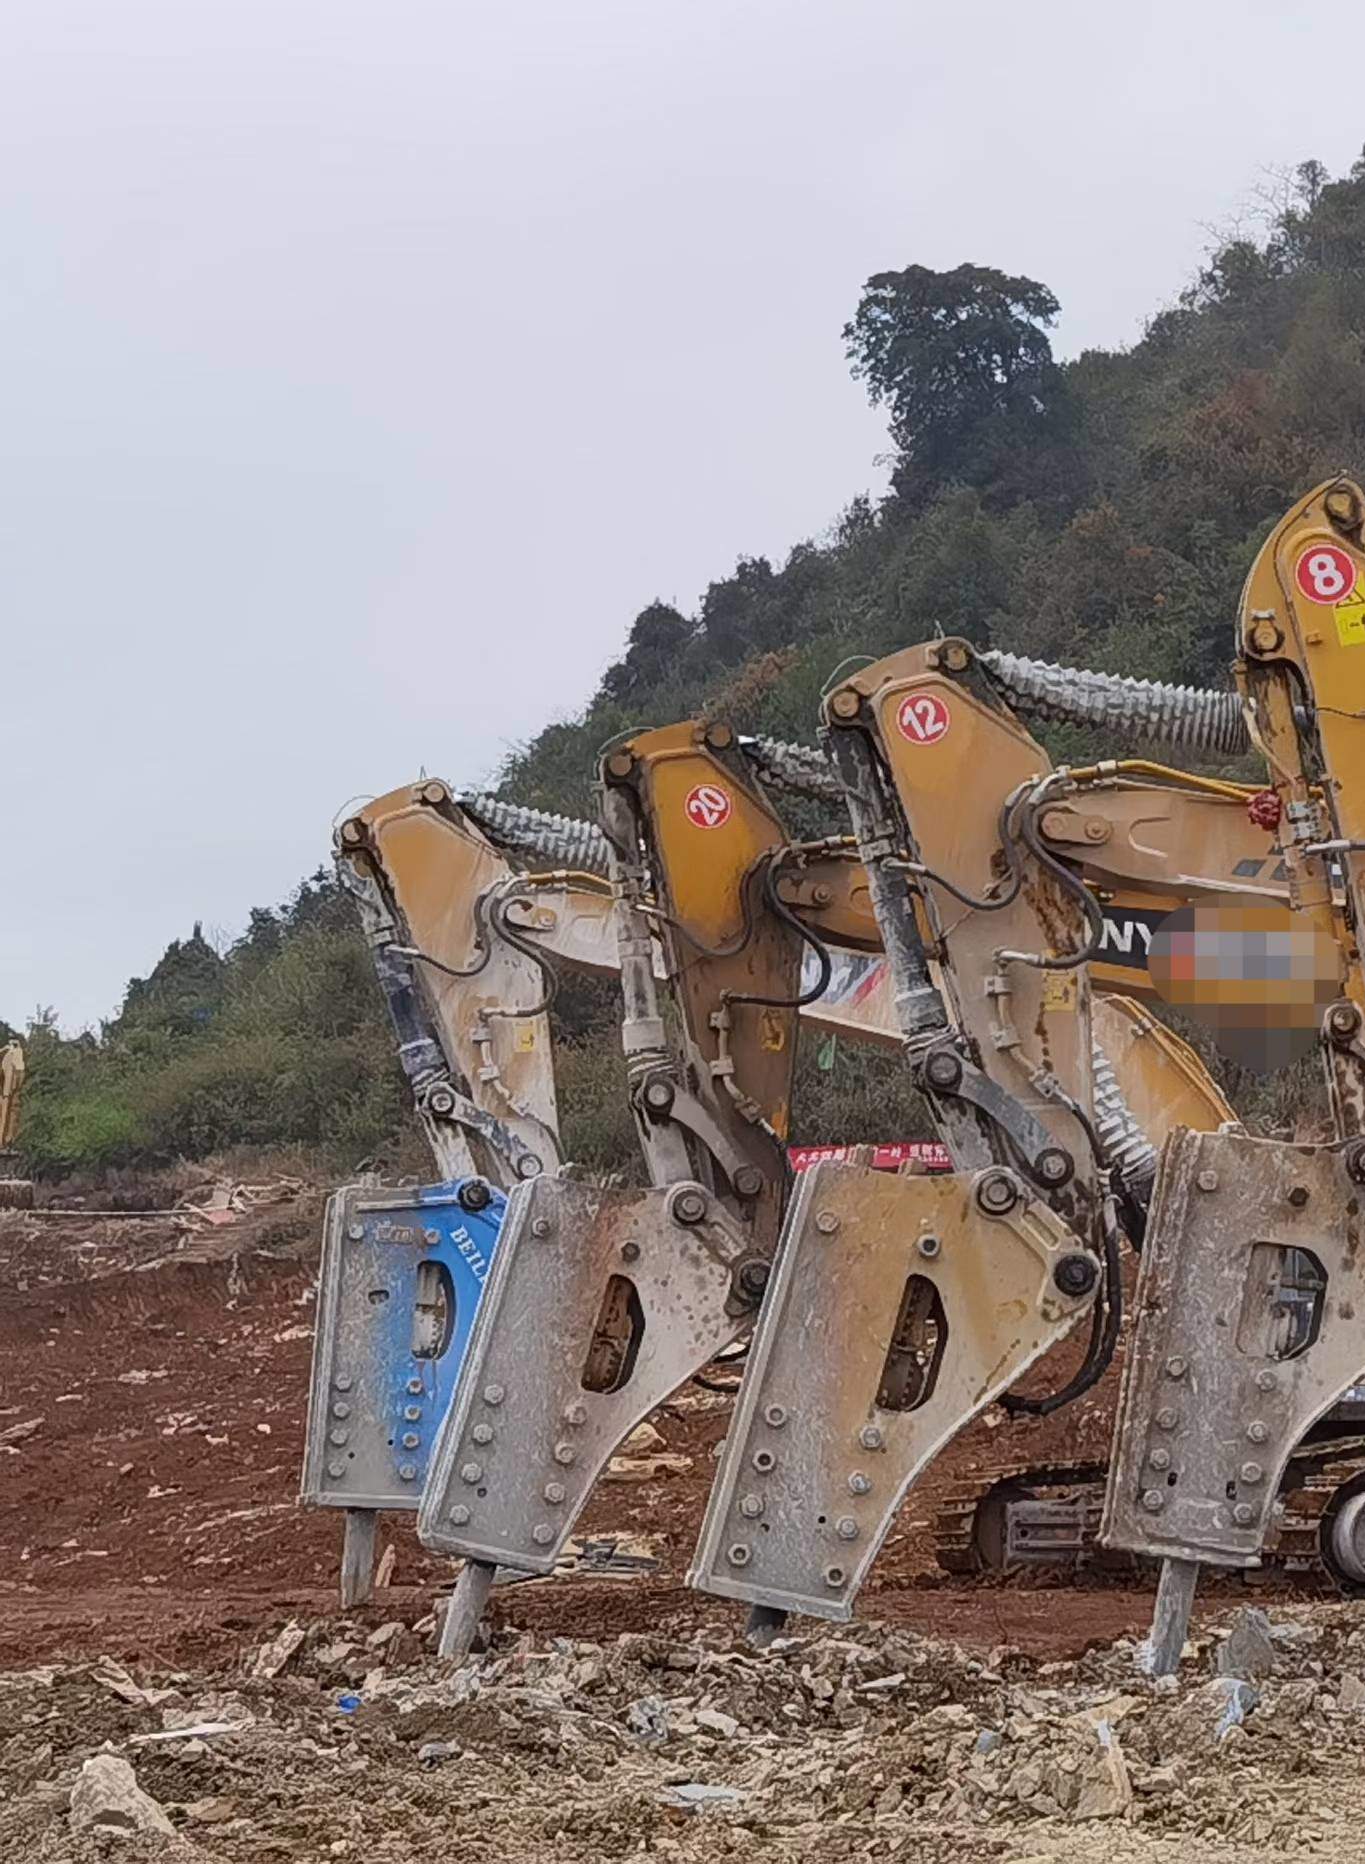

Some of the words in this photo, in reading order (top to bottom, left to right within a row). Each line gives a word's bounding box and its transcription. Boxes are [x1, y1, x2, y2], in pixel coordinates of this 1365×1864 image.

[1308, 554, 1345, 595] 8
[902, 699, 944, 739] 12
[690, 787, 726, 825] 20
